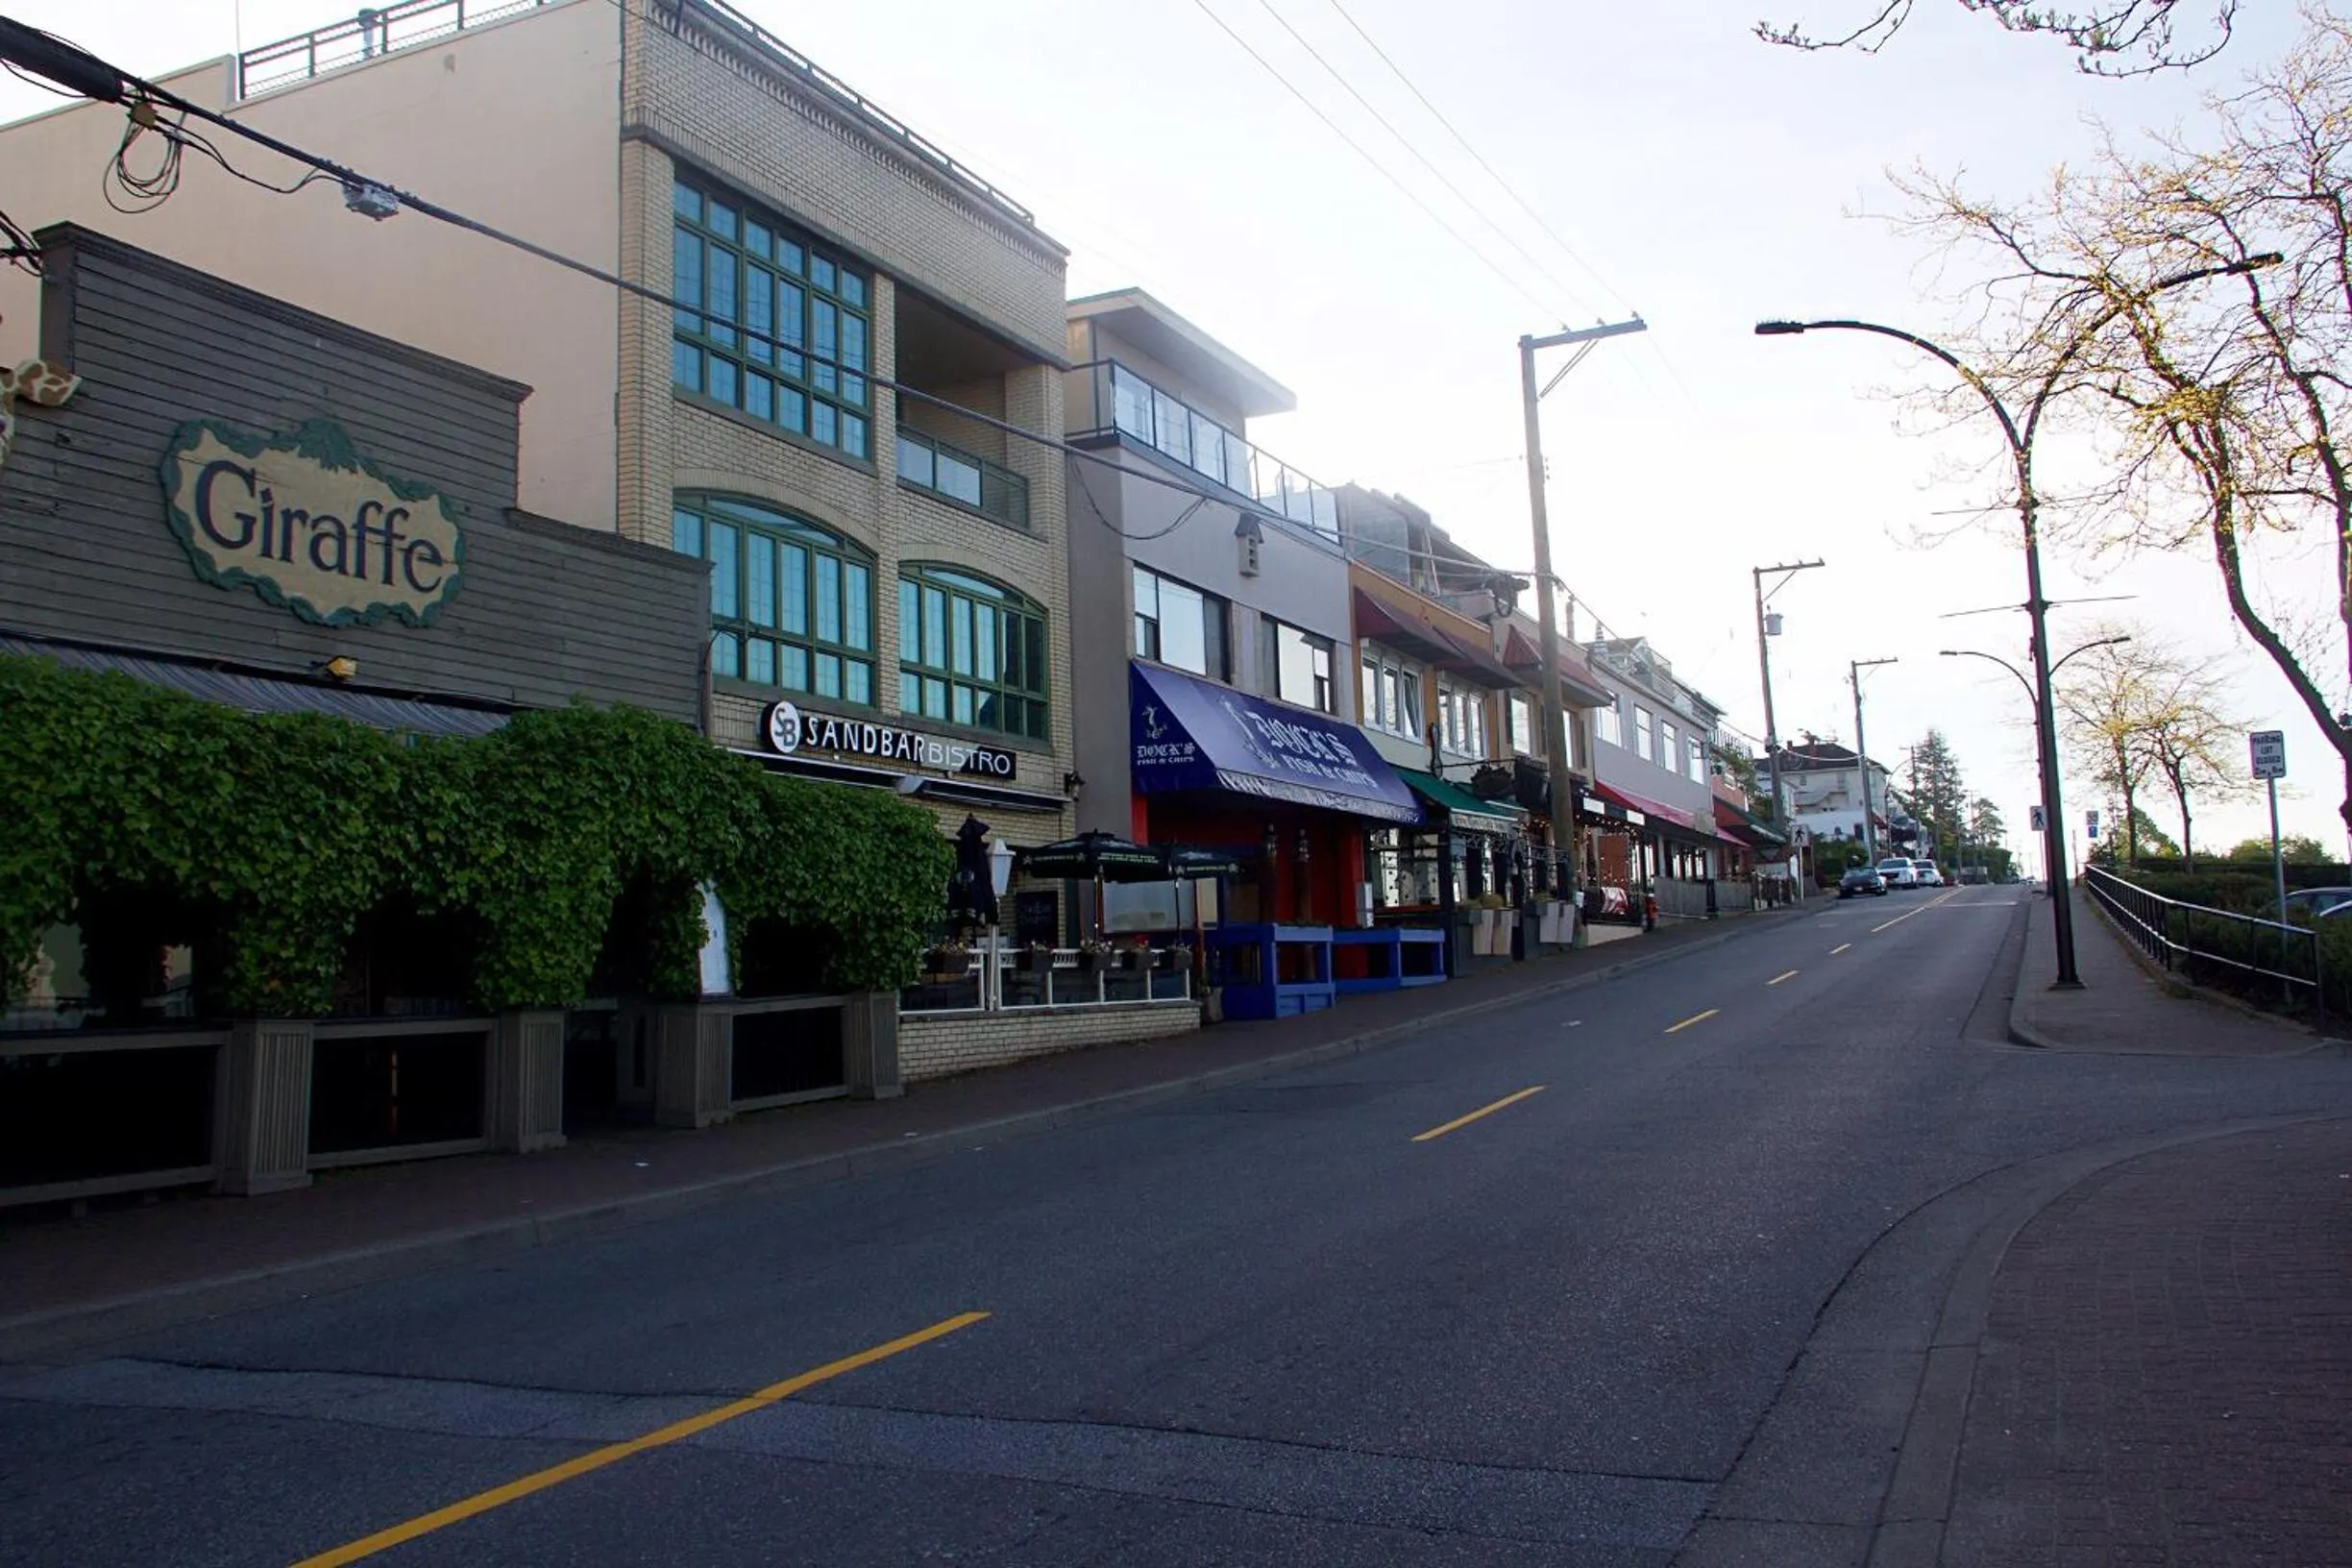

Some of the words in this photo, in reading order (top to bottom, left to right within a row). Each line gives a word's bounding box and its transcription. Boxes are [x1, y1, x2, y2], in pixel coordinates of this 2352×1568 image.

[196, 460, 443, 594] Giraffe
[806, 717, 924, 763] SANDBAR
[928, 743, 1011, 774] BISTRO
